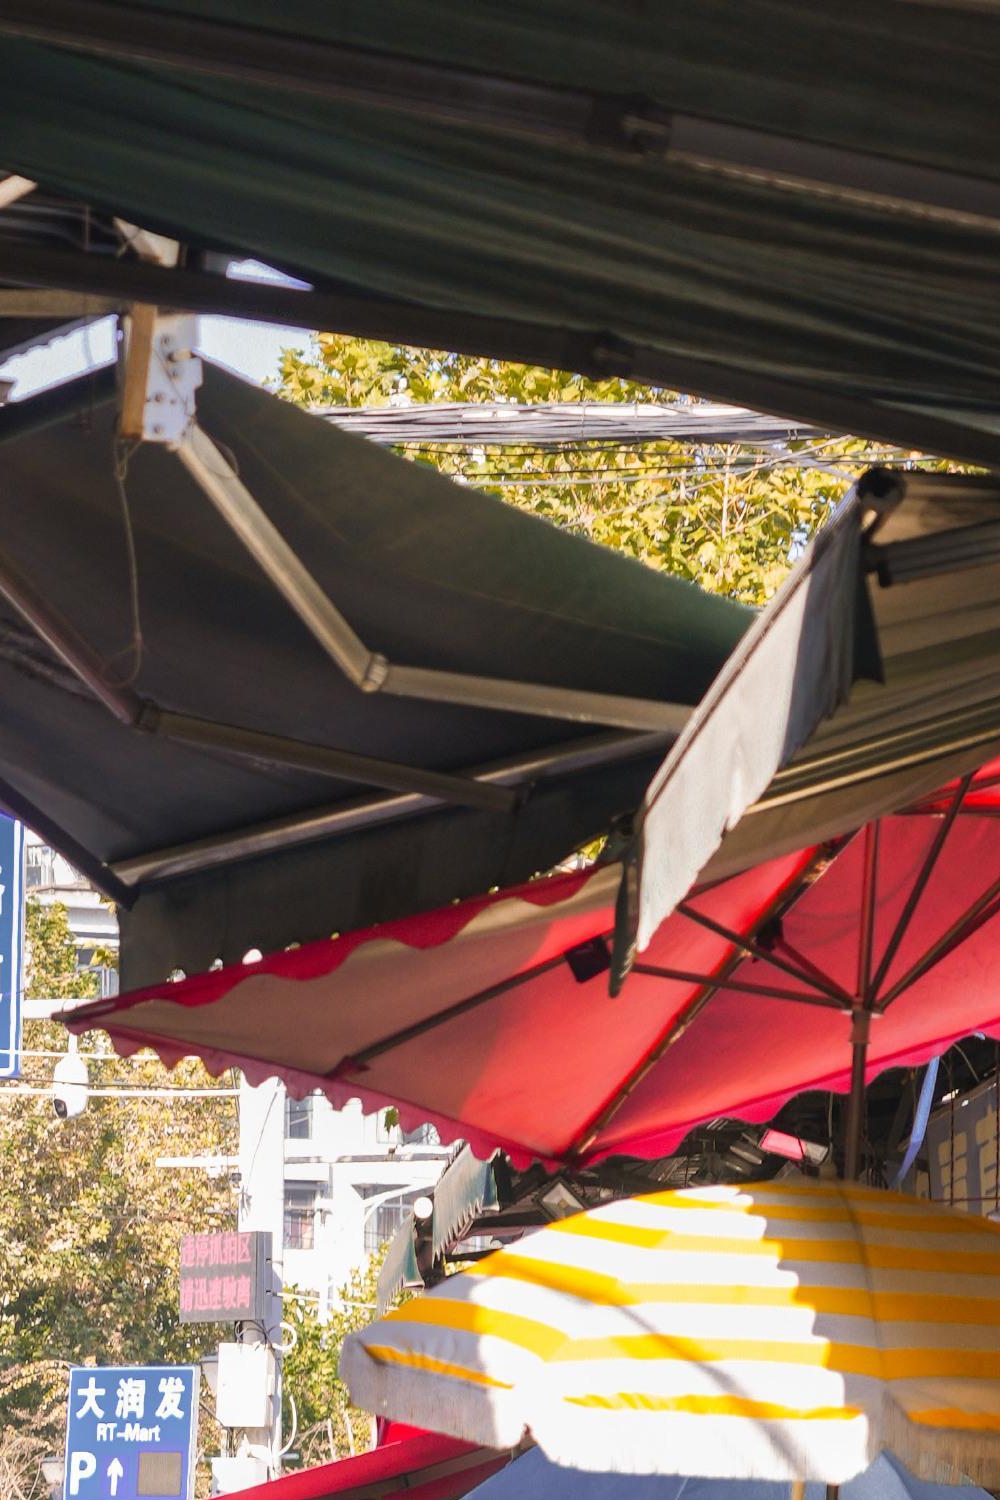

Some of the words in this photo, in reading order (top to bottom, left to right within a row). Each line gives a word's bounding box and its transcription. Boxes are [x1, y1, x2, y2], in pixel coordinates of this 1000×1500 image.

[75, 1376, 186, 1420] 大润发
[96, 1422, 161, 1442] RT-Mart
[69, 1451, 97, 1496] P
